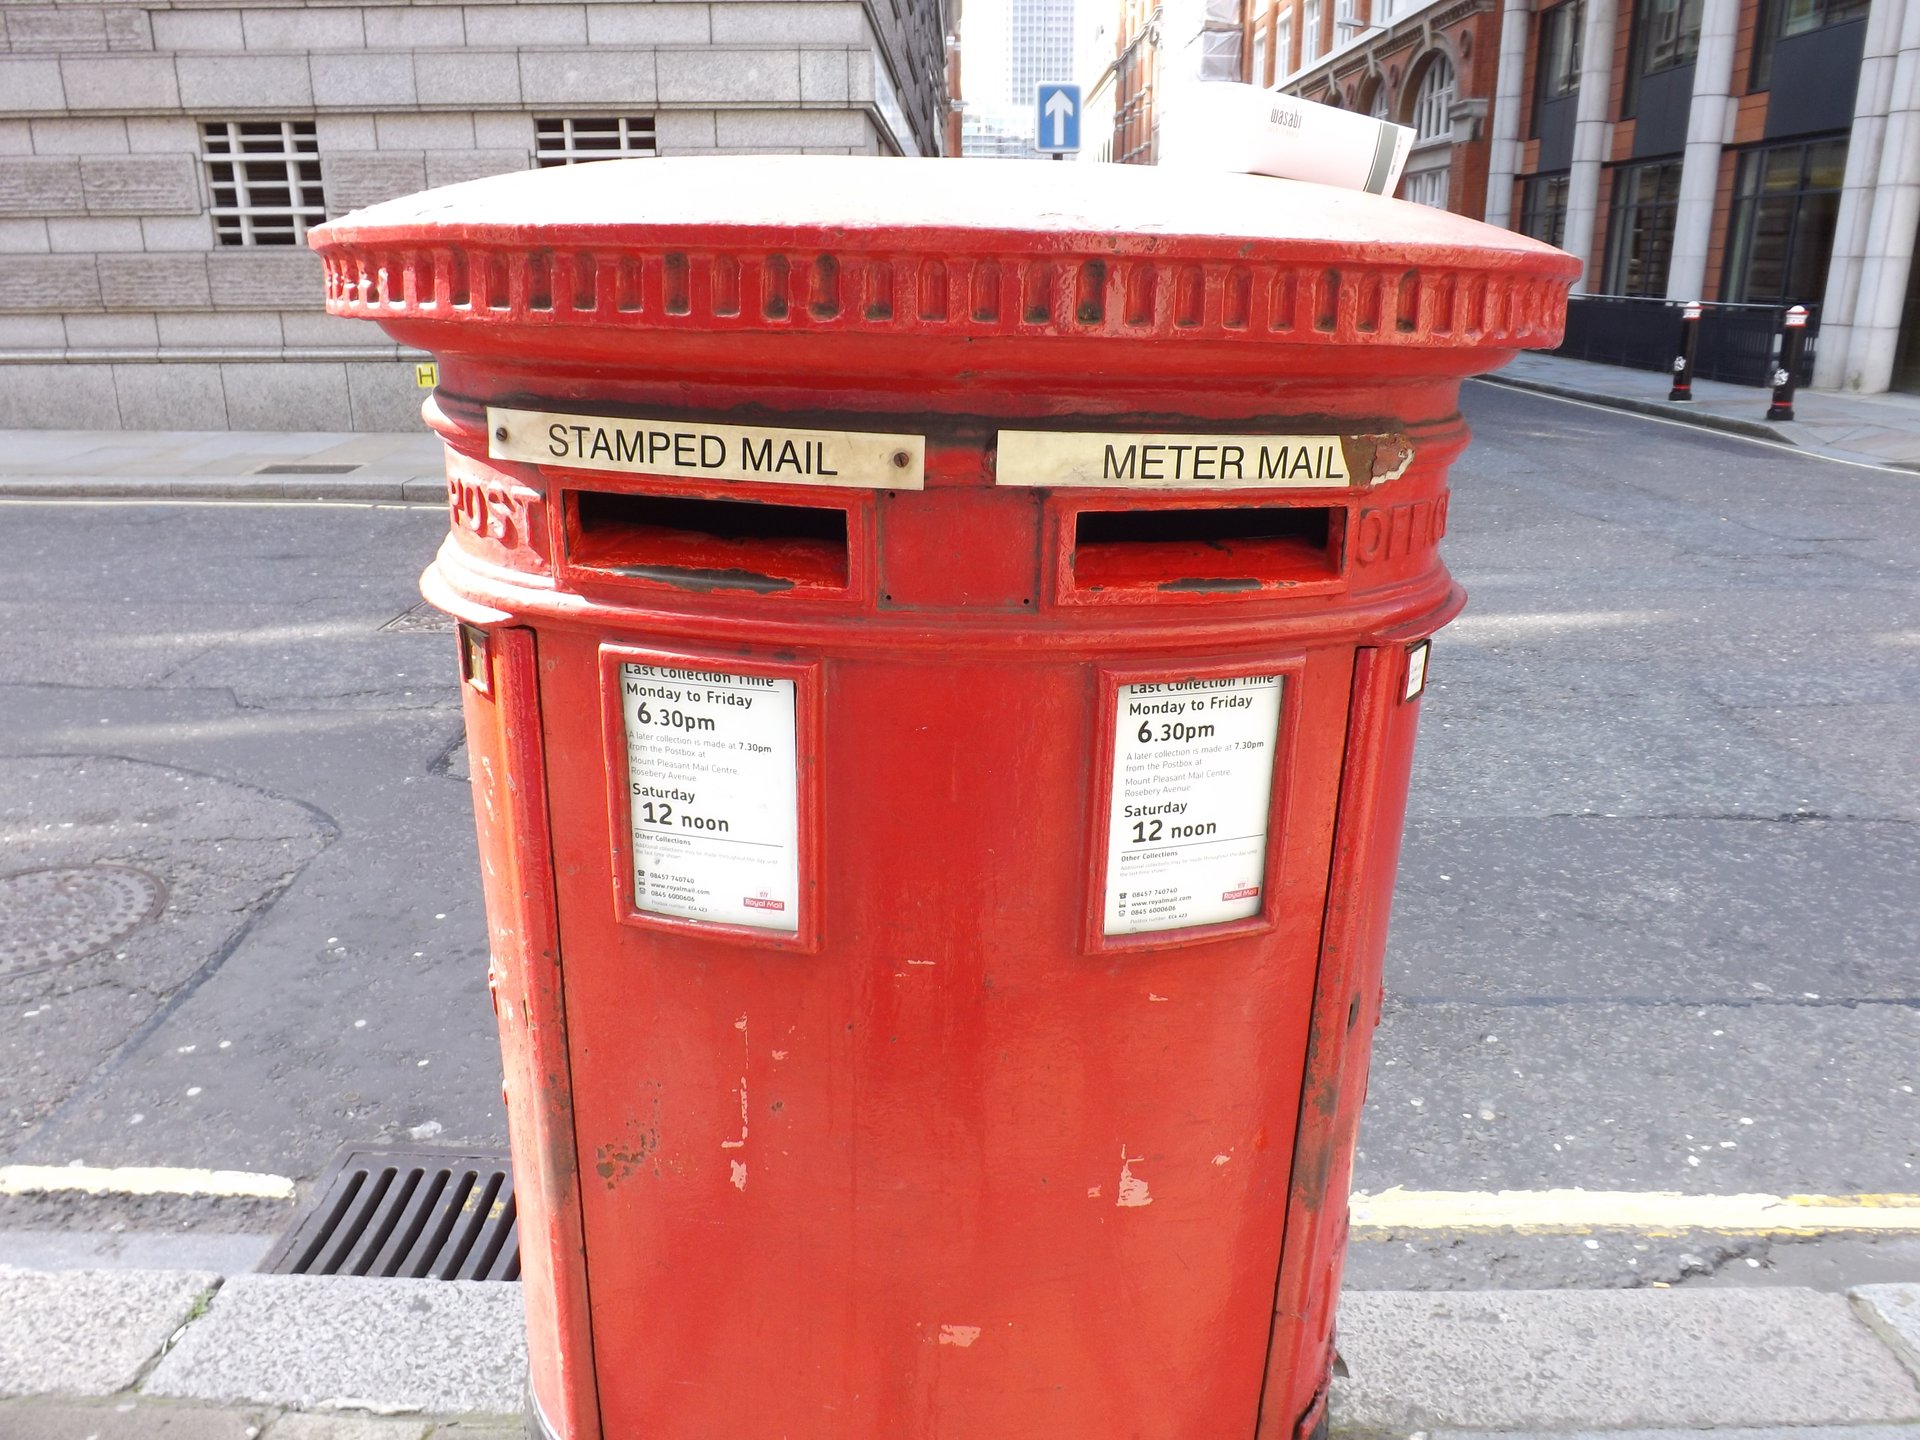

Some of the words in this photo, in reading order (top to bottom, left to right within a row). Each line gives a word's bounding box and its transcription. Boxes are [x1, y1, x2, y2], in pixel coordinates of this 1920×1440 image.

[1270, 107, 1302, 129] wasabi
[418, 367, 435, 385] H
[548, 423, 727, 468] STAMPED
[742, 438, 838, 476] MAIL
[1103, 444, 1244, 480] METER
[1258, 445, 1344, 480] MAIL
[625, 663, 655, 676] Last
[660, 667, 731, 683] Collection
[626, 682, 681, 702] Monday
[687, 690, 701, 702] to
[707, 690, 753, 709] Friday
[1130, 683, 1161, 695] Last
[1129, 700, 1186, 716] Monday
[1191, 700, 1205, 711] to
[1210, 694, 1253, 709] Friday
[637, 701, 715, 732] 6.30pm
[1137, 720, 1215, 744] 6.30pm
[629, 742, 648, 751] from
[650, 744, 663, 753] the
[665, 745, 696, 756] Postbox
[636, 731, 653, 740] later
[656, 735, 692, 745] collection
[703, 740, 726, 749] made
[728, 742, 736, 750] at
[739, 741, 772, 754] 7.30pm
[1126, 752, 1132, 761] A
[1134, 752, 1152, 761] later
[1154, 748, 1190, 759] collection
[1201, 745, 1222, 754] made
[1224, 744, 1232, 752] at
[1235, 740, 1264, 750] 7.30pm
[630, 755, 655, 766] Mount
[657, 758, 690, 770] Pleasant
[692, 763, 709, 772] Mail
[1126, 763, 1145, 773] from
[1147, 762, 1160, 771] the
[1162, 760, 1193, 769] Postbox
[631, 766, 666, 780] Rosebery
[668, 771, 697, 782] Avenue
[1125, 777, 1151, 787] Mount
[1153, 774, 1186, 783] Pleasant
[1188, 771, 1204, 780] Mail
[632, 783, 695, 804] Saturday
[1124, 788, 1161, 798] Rosebery
[1162, 785, 1191, 794] Avenue
[642, 801, 673, 826] 12
[680, 814, 729, 832] noon
[1124, 801, 1188, 818] Saturday
[635, 832, 654, 841] Other
[655, 834, 691, 846] Collections
[1132, 819, 1163, 844] 12
[1170, 821, 1217, 839] noon
[1142, 850, 1178, 860] Collections
[649, 872, 669, 881] 08457
[671, 874, 695, 885] 740740
[651, 882, 711, 896] www.royalmail.com
[651, 890, 667, 898] 0845
[1132, 890, 1152, 899] 08457
[1154, 887, 1178, 896] 740740
[745, 898, 766, 908] Royal
[766, 901, 783, 909] Mail
[1131, 895, 1192, 907] www.royalmail.com
[1130, 908, 1147, 916] 0845
[1148, 905, 1176, 914] 6000606
